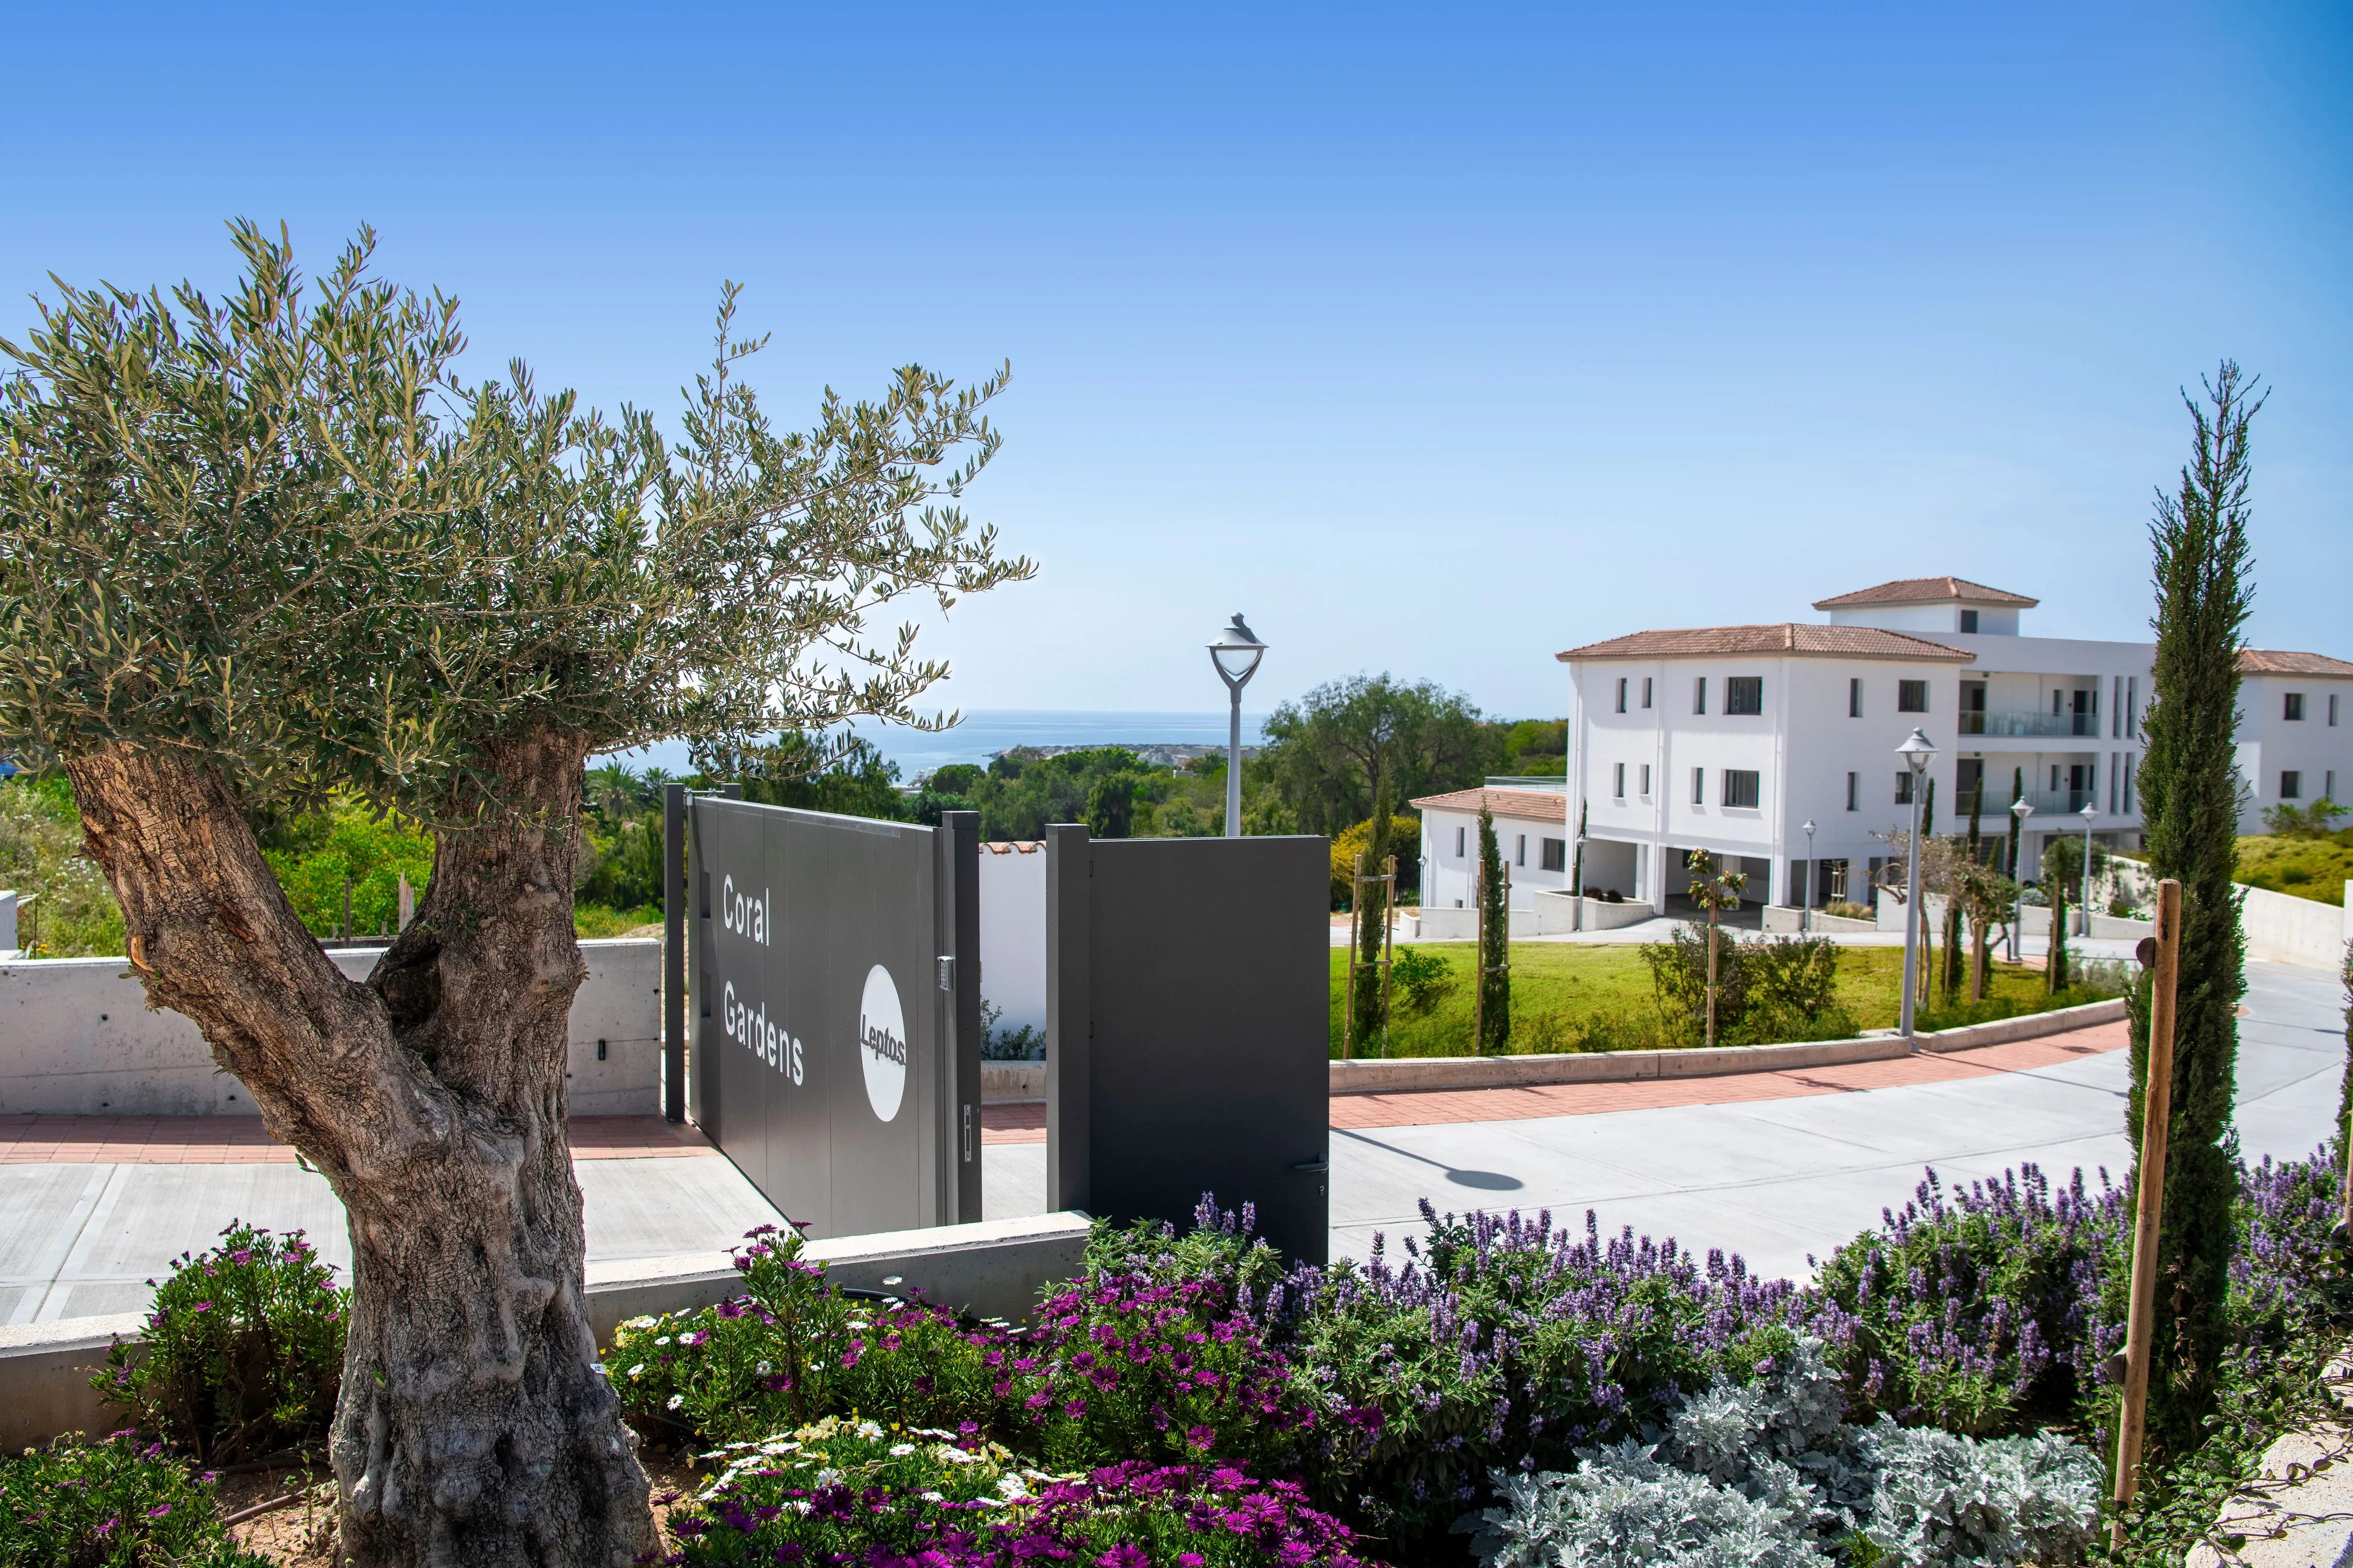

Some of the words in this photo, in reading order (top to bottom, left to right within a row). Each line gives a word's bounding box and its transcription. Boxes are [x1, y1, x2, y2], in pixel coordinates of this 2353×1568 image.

[723, 874, 769, 947] Coral
[724, 980, 804, 1086] Gardens
[861, 1014, 905, 1065] Leptos
